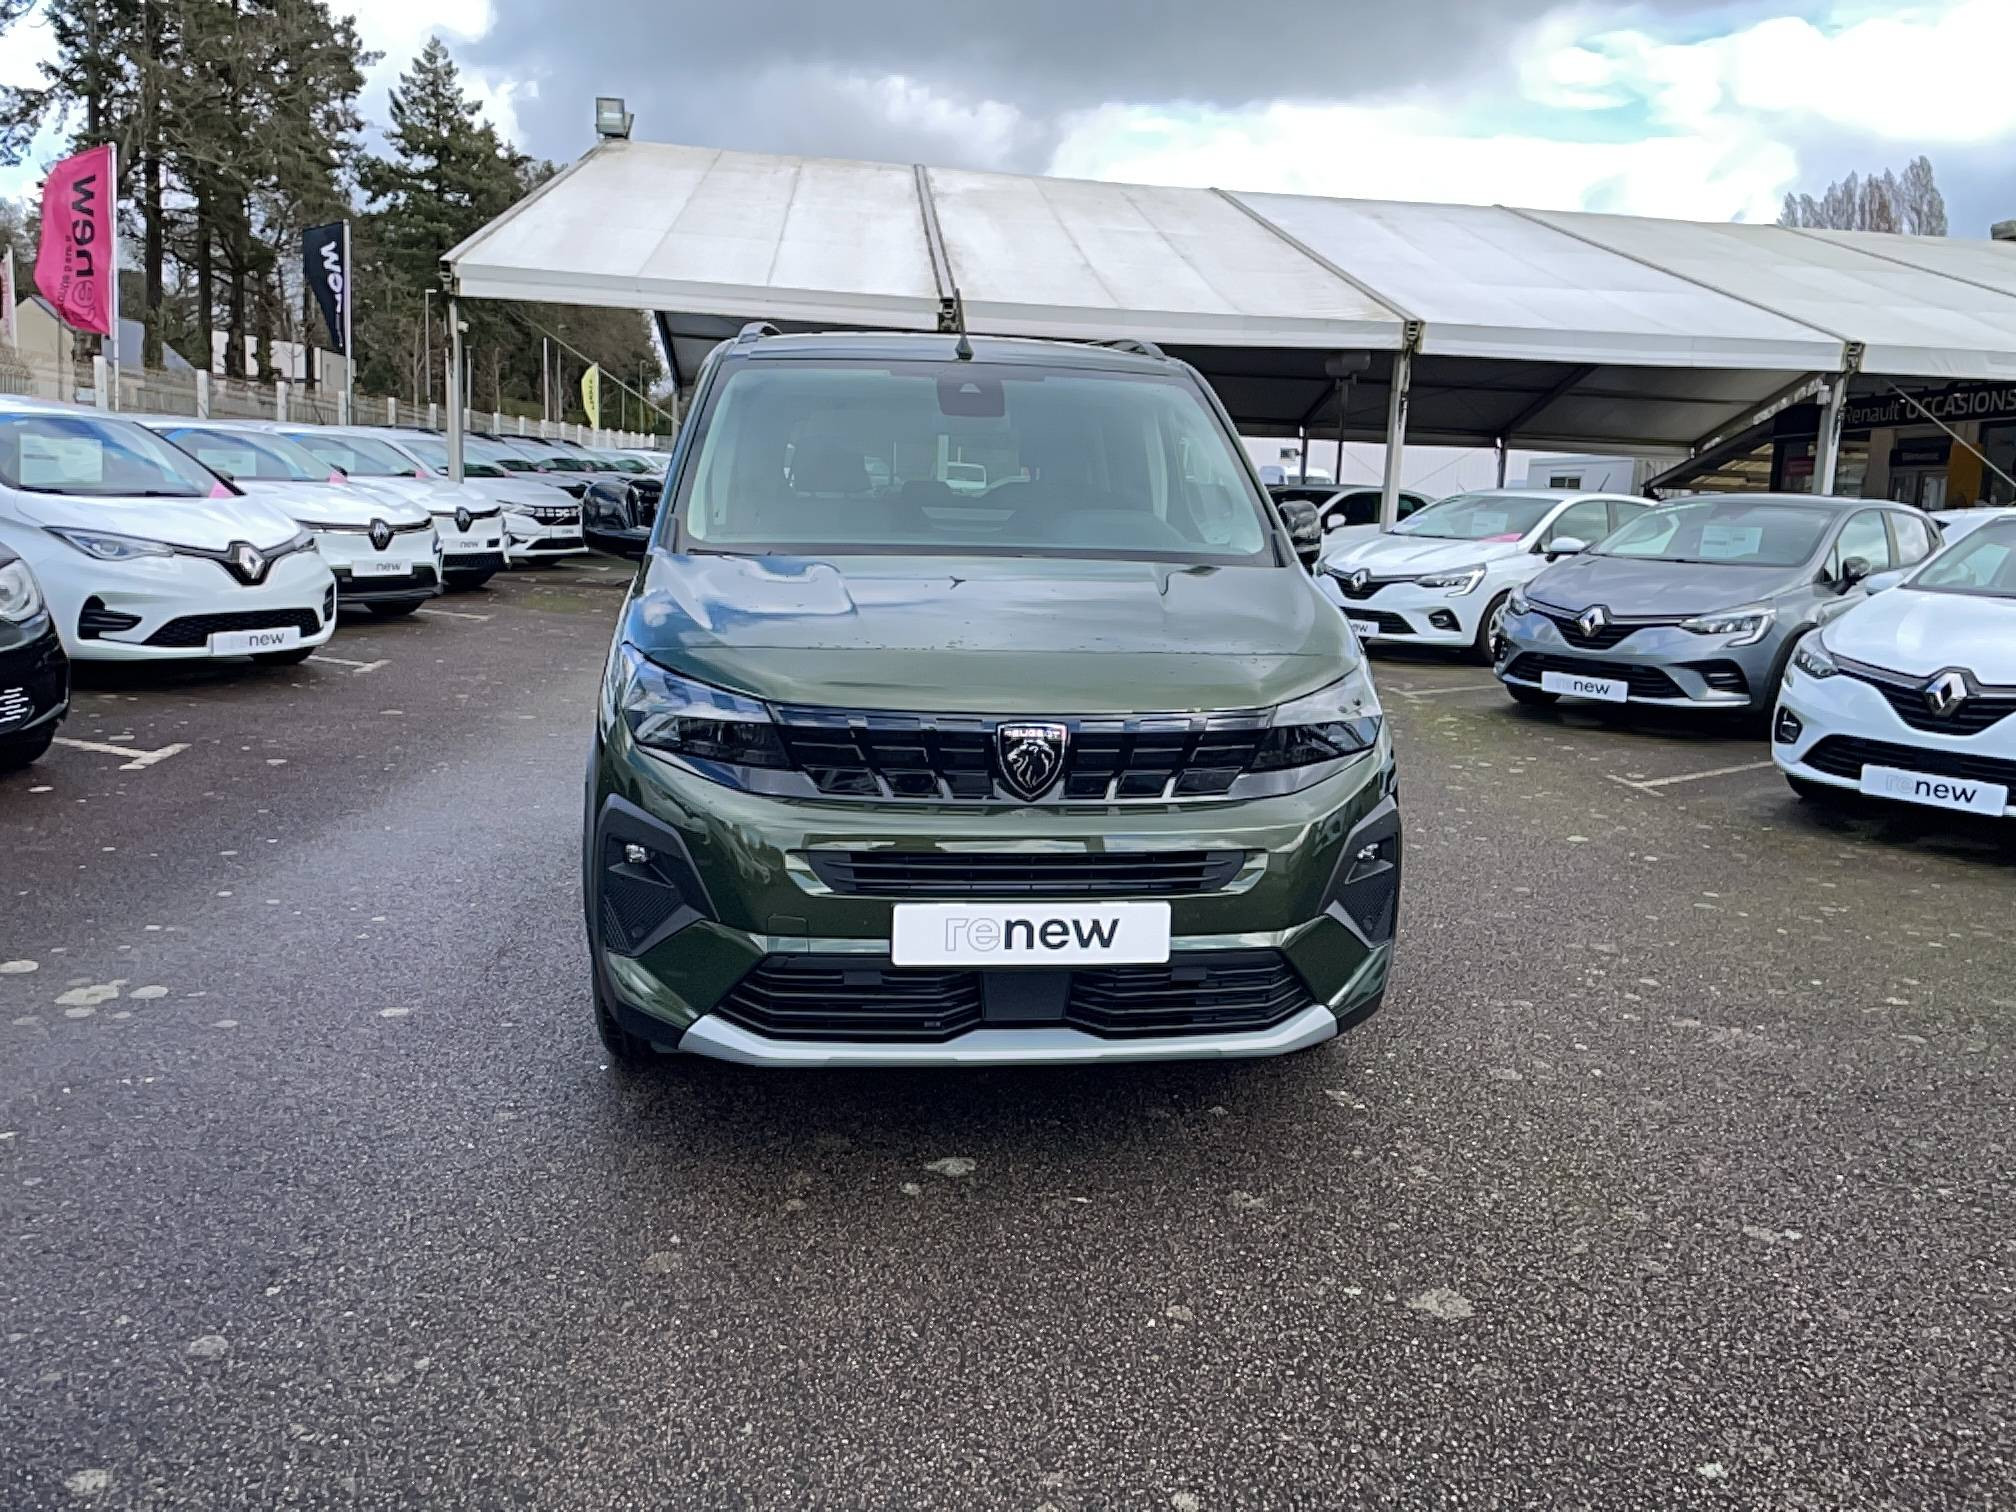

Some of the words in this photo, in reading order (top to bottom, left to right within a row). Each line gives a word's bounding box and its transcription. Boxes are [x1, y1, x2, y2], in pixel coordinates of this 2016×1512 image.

[1843, 403, 1902, 425] Renault
[1905, 388, 2016, 419] OCCASIONS
[1885, 774, 1977, 804] renew
[945, 917, 1120, 952] renew
